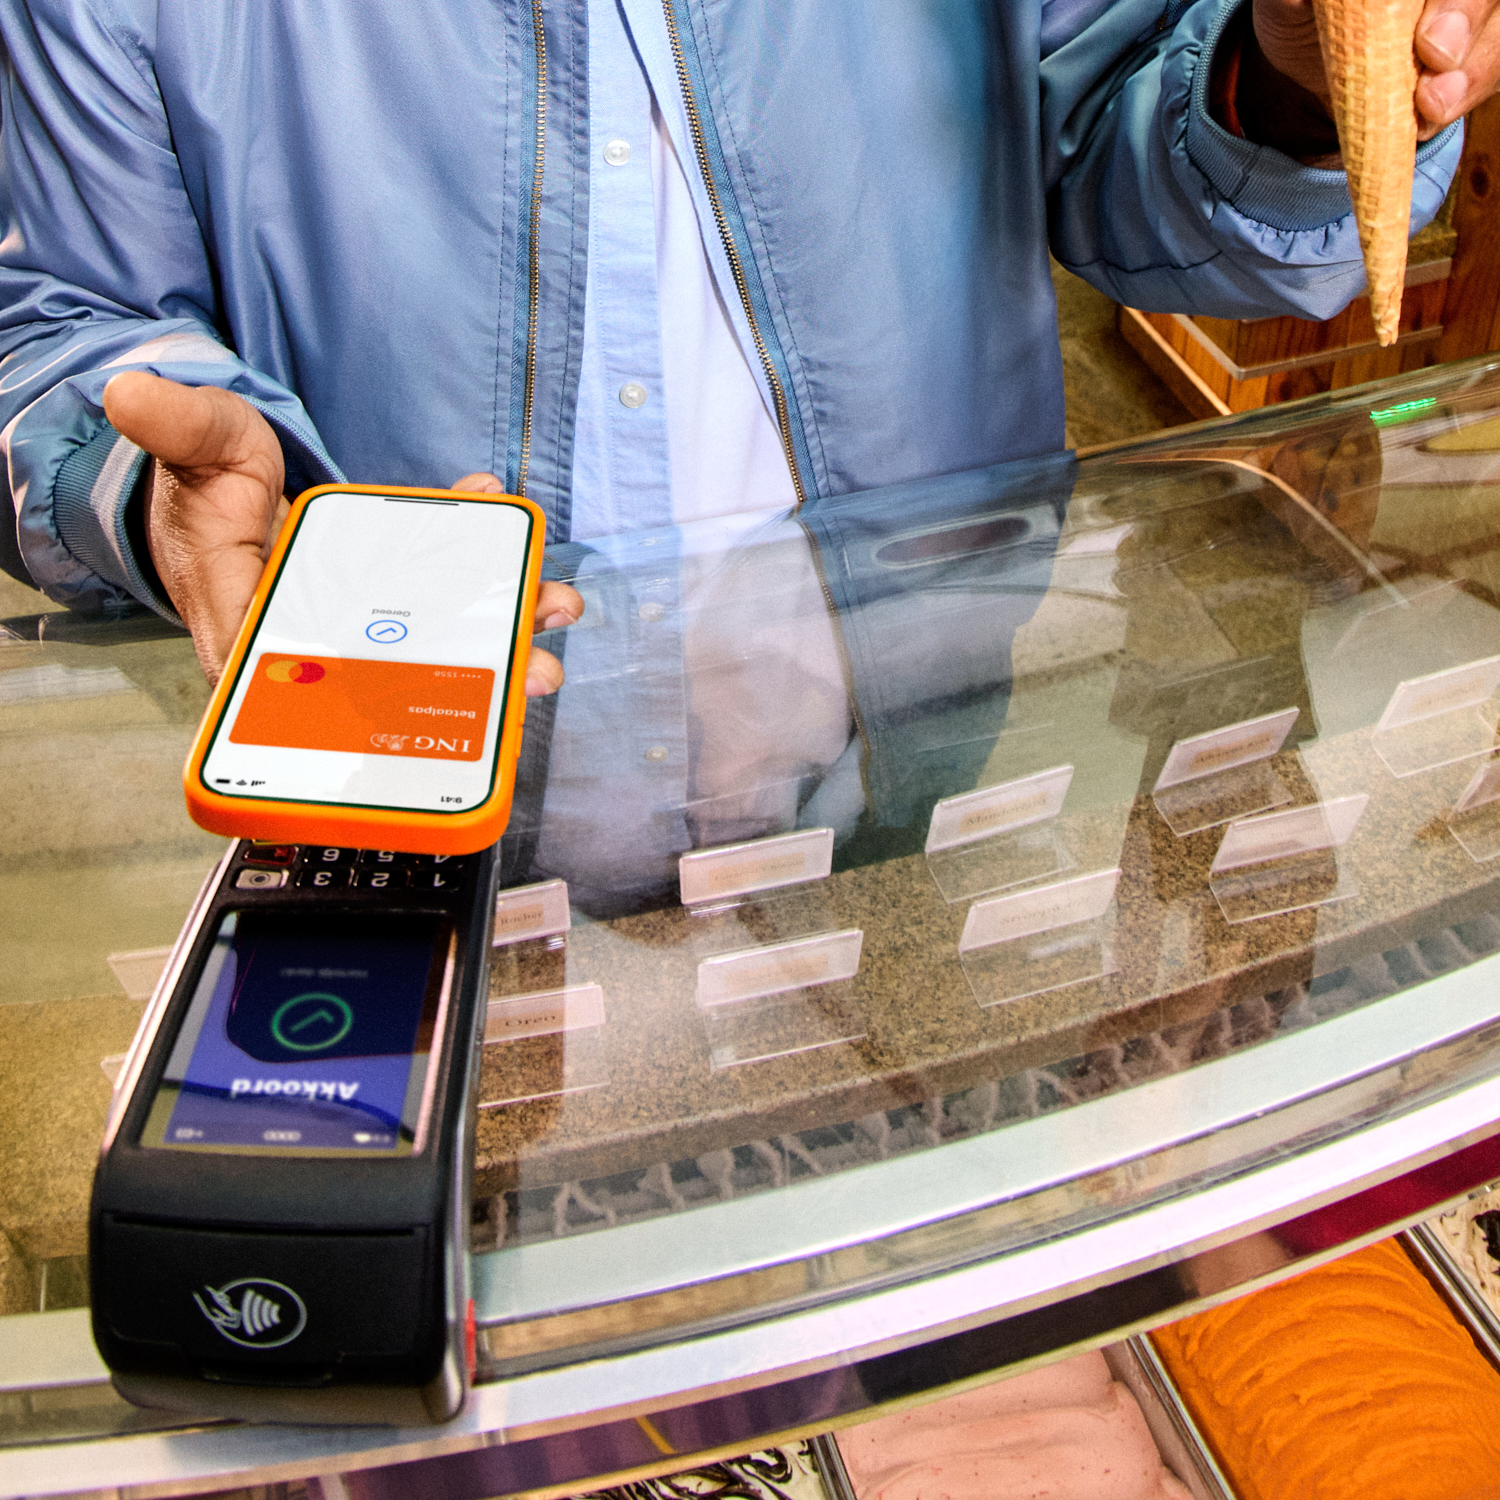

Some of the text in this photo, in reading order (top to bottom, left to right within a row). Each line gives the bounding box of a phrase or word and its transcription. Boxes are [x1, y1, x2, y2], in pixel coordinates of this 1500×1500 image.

[371, 608, 411, 617] Gereed
[408, 706, 476, 719] Betaalpas
[414, 736, 471, 753] ING
[440, 796, 462, 804] 9:41
[322, 848, 340, 862] 6
[313, 871, 446, 887] 1 2 3
[505, 1015, 556, 1027] Oreo
[231, 1078, 360, 1100] Akkoord
